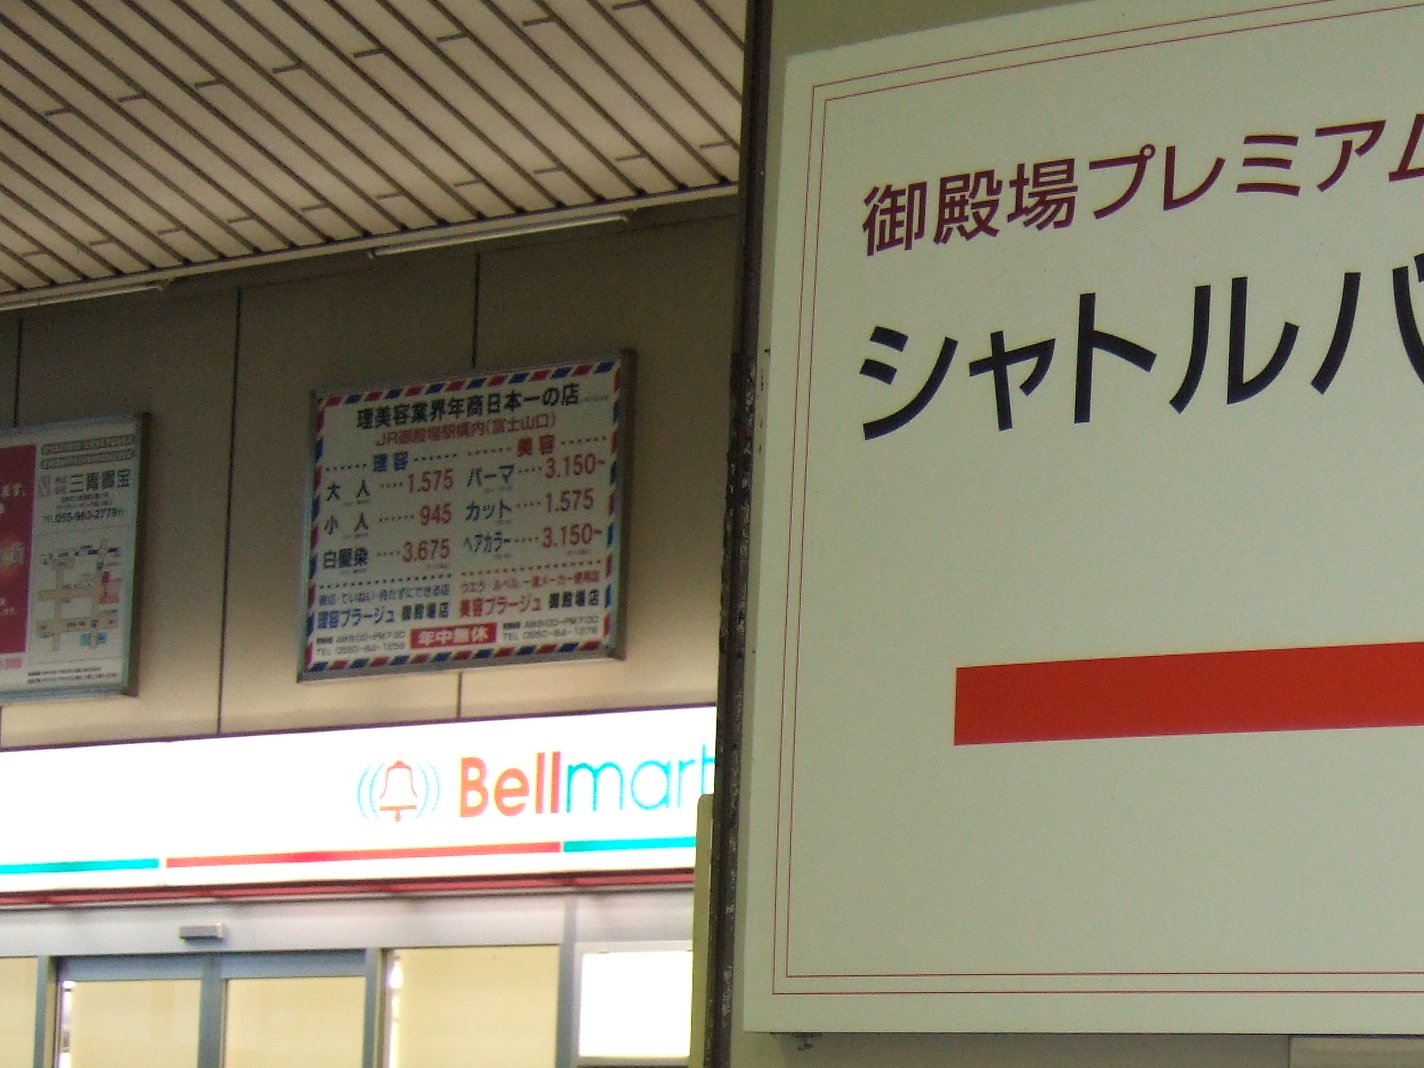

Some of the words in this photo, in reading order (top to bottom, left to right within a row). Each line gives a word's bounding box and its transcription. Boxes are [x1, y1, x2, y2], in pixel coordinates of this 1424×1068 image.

[356, 383, 580, 430] 理美容業界年商日本一の店
[466, 465, 515, 488] パーマ
[419, 503, 452, 525] 945
[464, 501, 512, 522] カット
[462, 532, 511, 554] ヘアカラー
[459, 744, 716, 819] Bellmart
